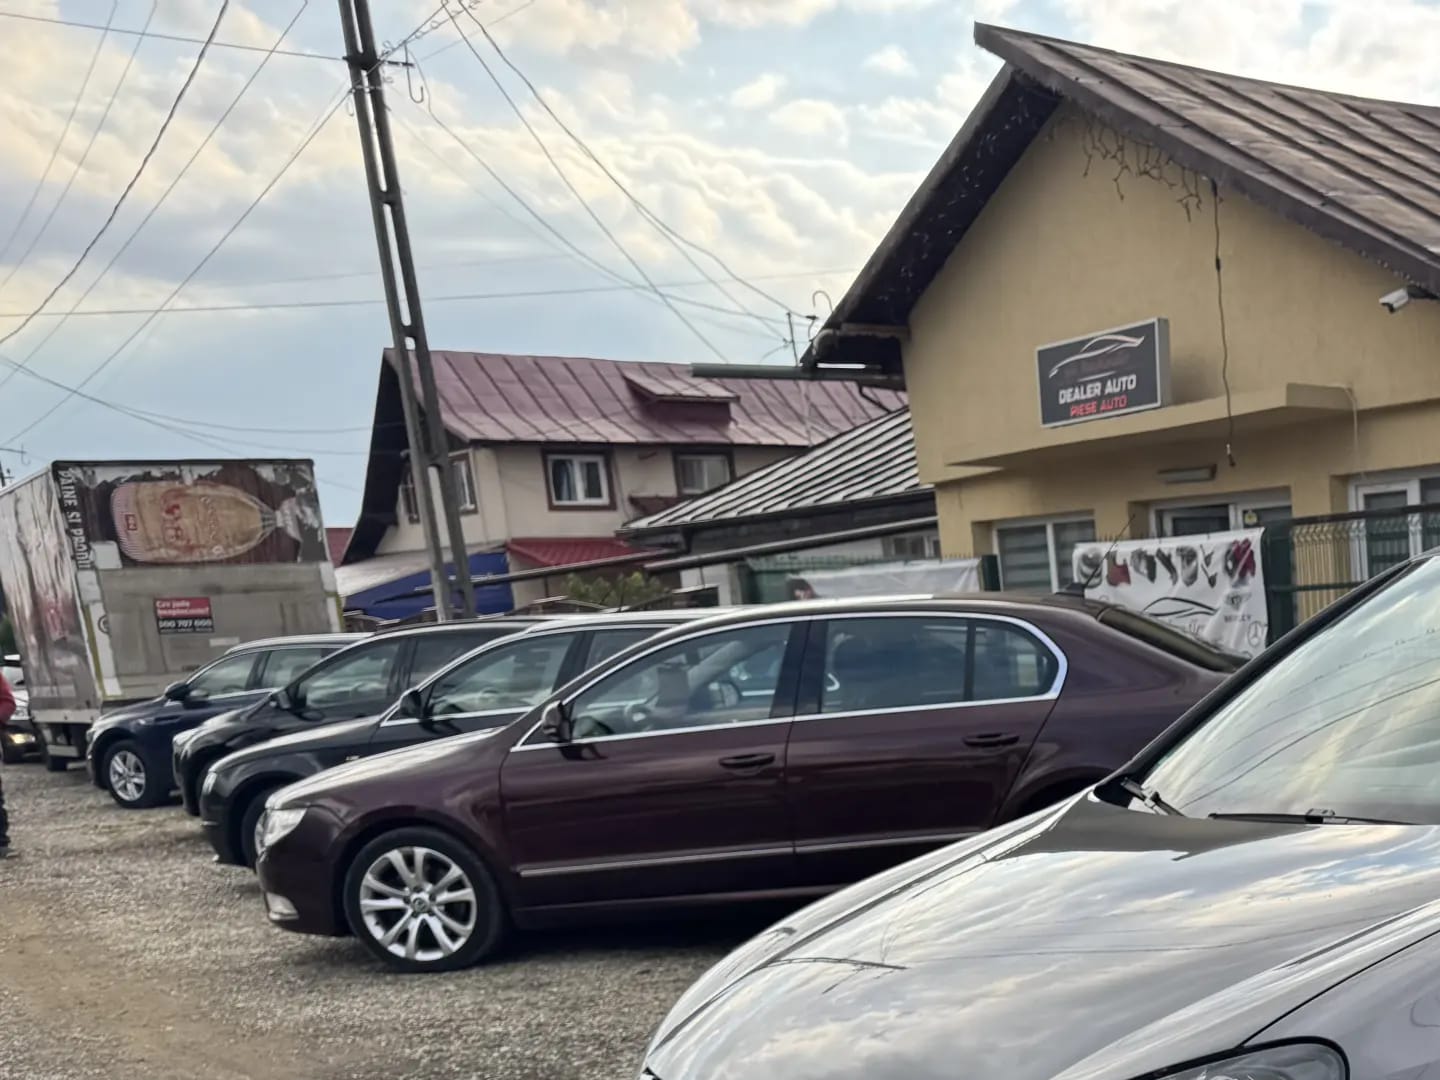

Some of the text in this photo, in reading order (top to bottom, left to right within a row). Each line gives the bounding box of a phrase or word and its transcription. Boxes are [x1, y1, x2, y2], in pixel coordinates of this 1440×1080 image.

[1059, 373, 1137, 405] DEALER AUTO
[1070, 394, 1128, 417] PIESE AUTO
